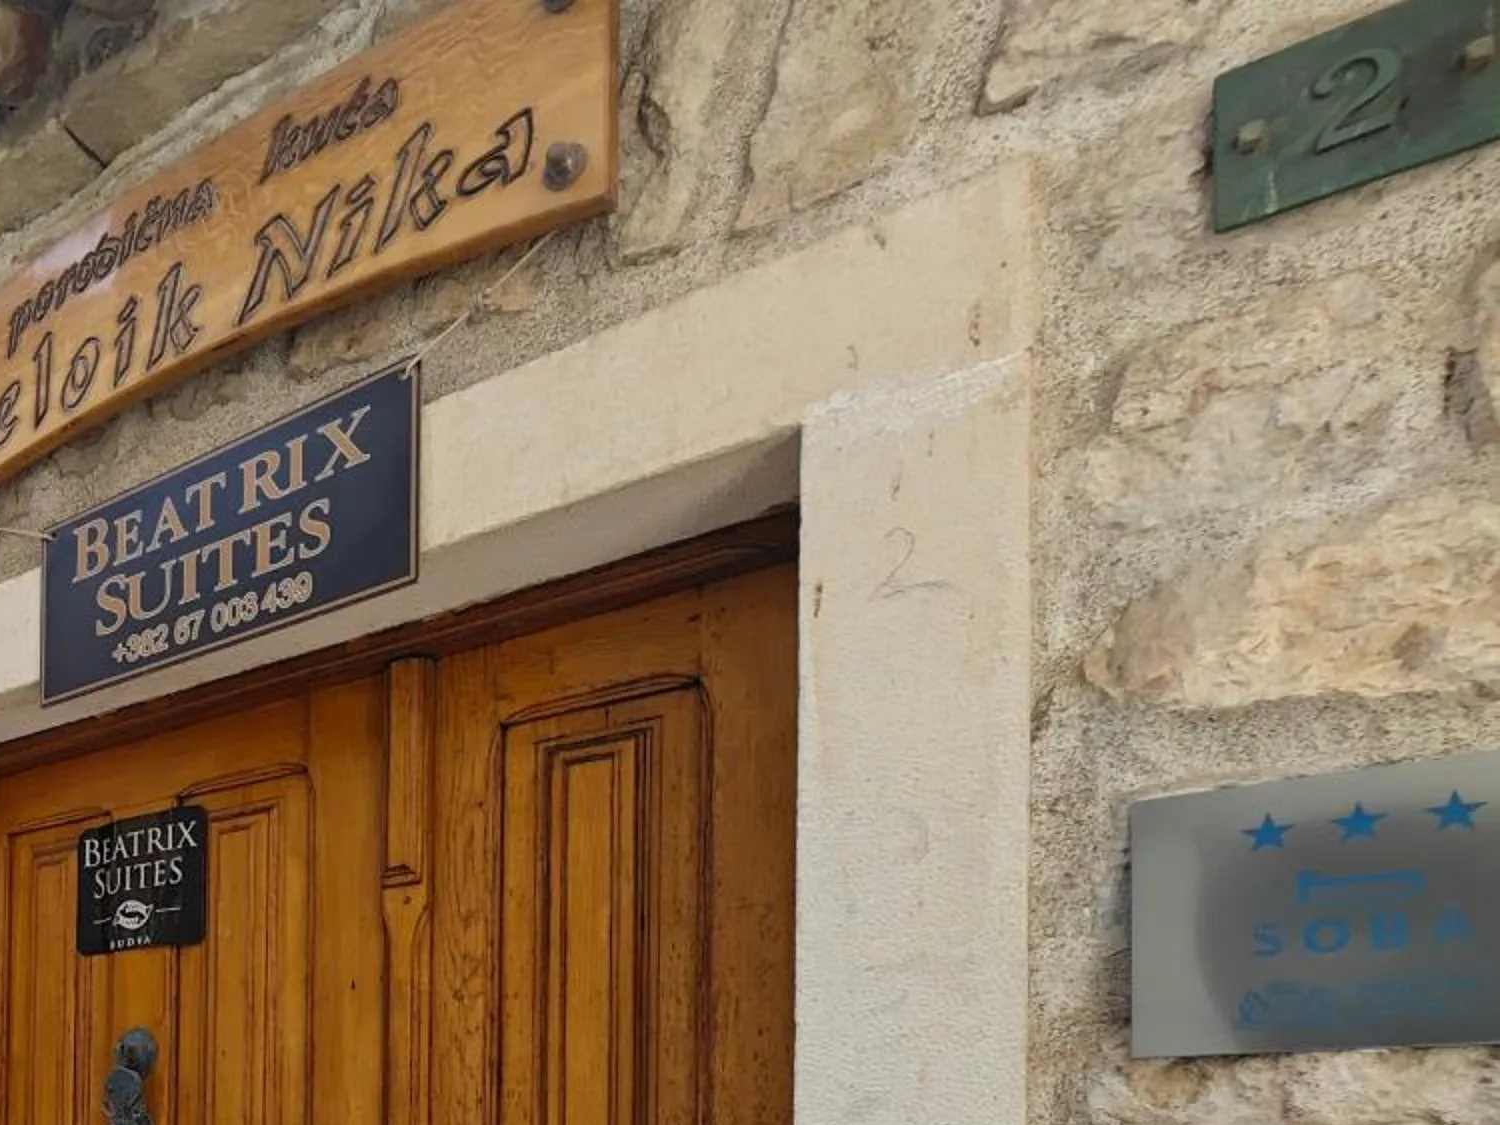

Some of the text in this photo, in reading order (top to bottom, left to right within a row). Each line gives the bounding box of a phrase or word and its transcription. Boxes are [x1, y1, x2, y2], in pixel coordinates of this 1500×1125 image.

[1309, 48, 1399, 156] 2
[71, 404, 372, 585] BEATRIX
[95, 497, 332, 637] SUITES
[84, 819, 198, 868] BEATRIX
[93, 855, 184, 900] SUITES
